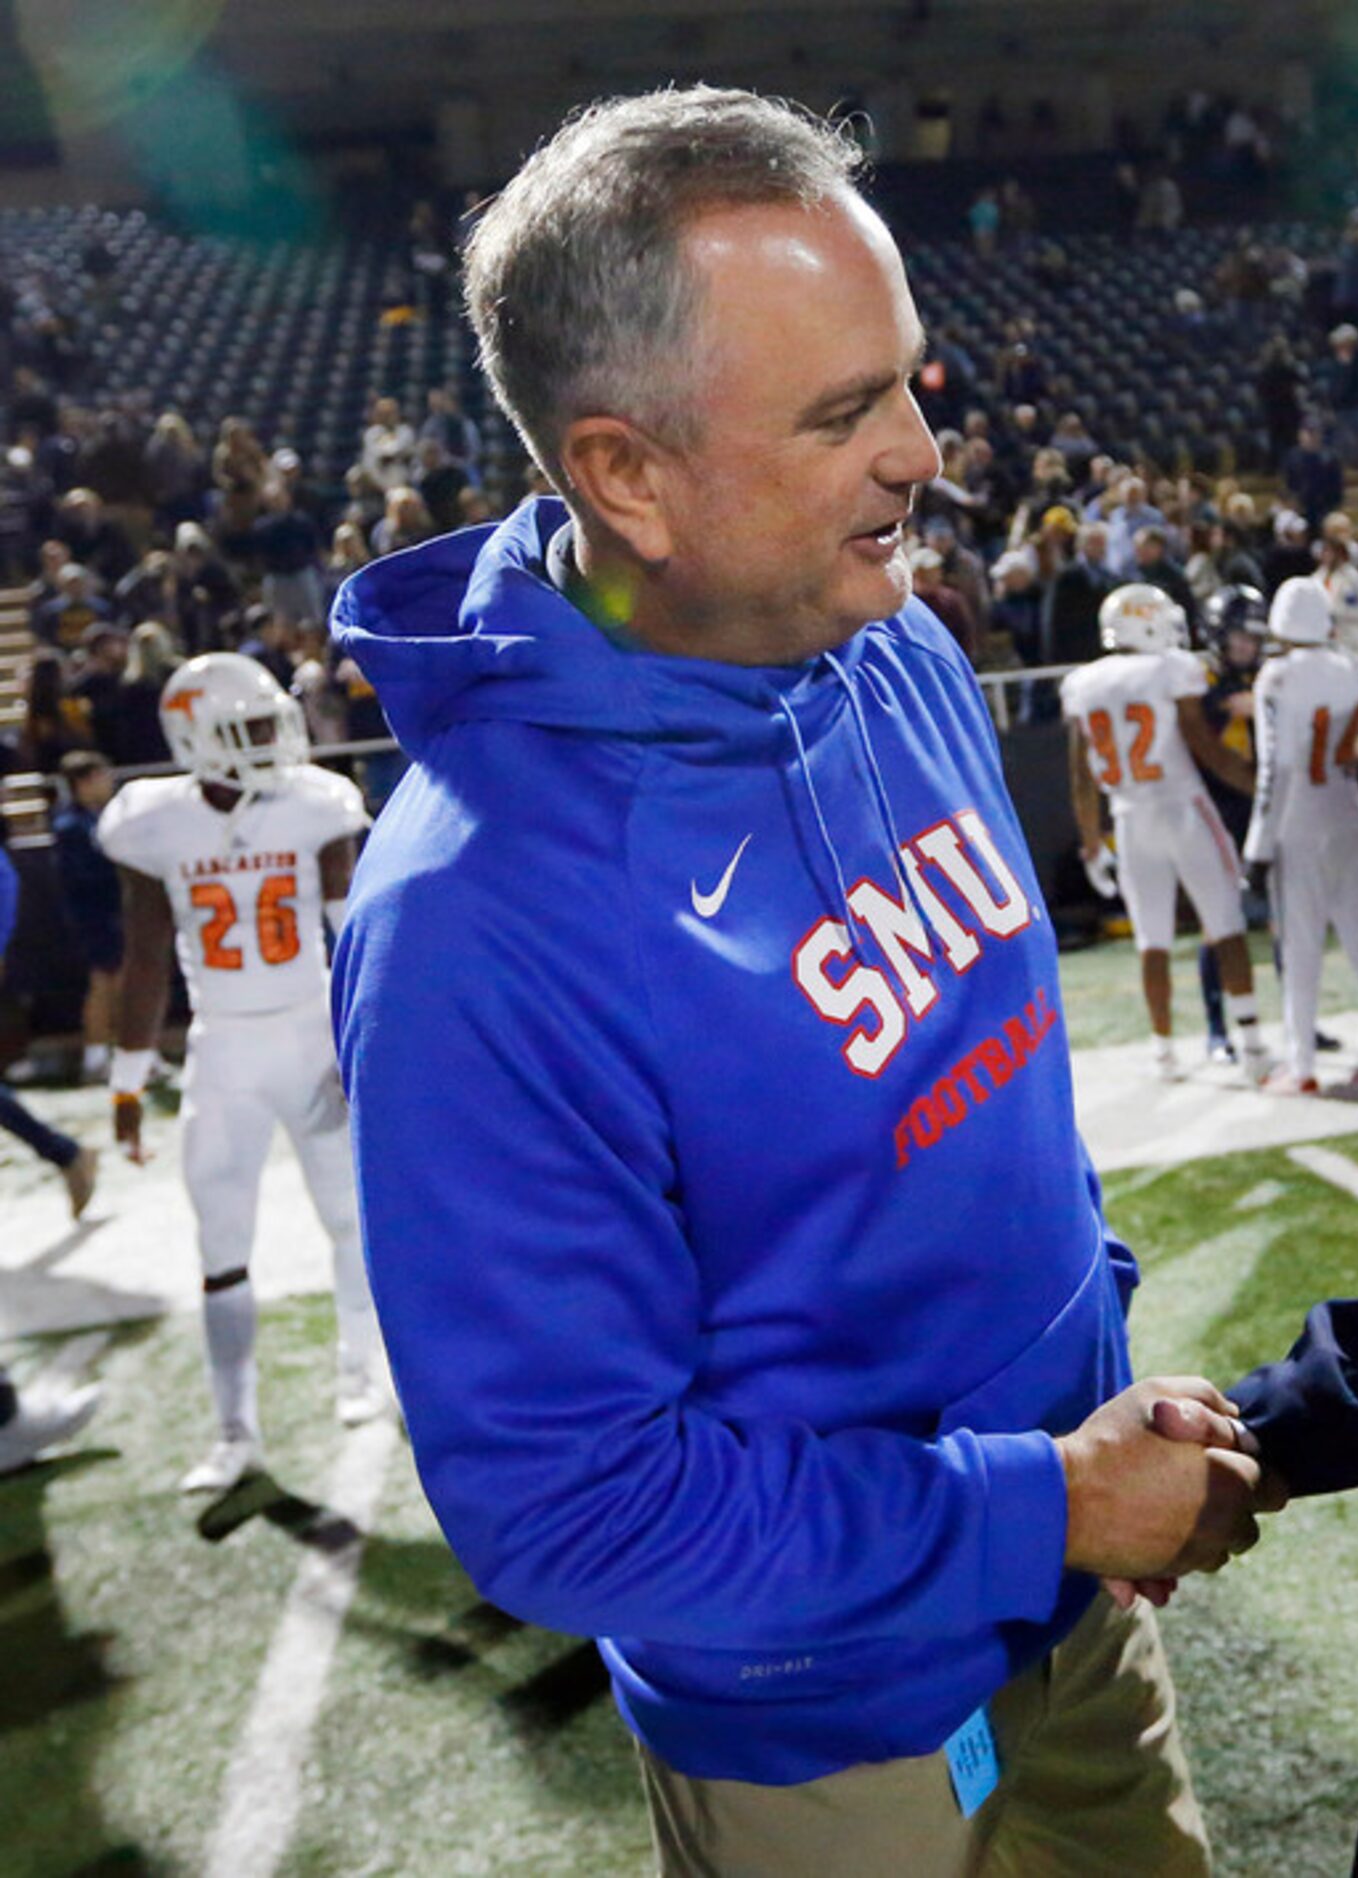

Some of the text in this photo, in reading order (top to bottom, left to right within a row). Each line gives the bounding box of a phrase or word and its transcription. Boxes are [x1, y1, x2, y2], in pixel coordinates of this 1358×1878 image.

[179, 851, 298, 880] LANCASTER
[190, 873, 300, 971] 26
[790, 808, 1031, 1079] SMU
[893, 986, 1058, 1170] FOOTBALL
[740, 1656, 814, 1680] DRI-FIT
